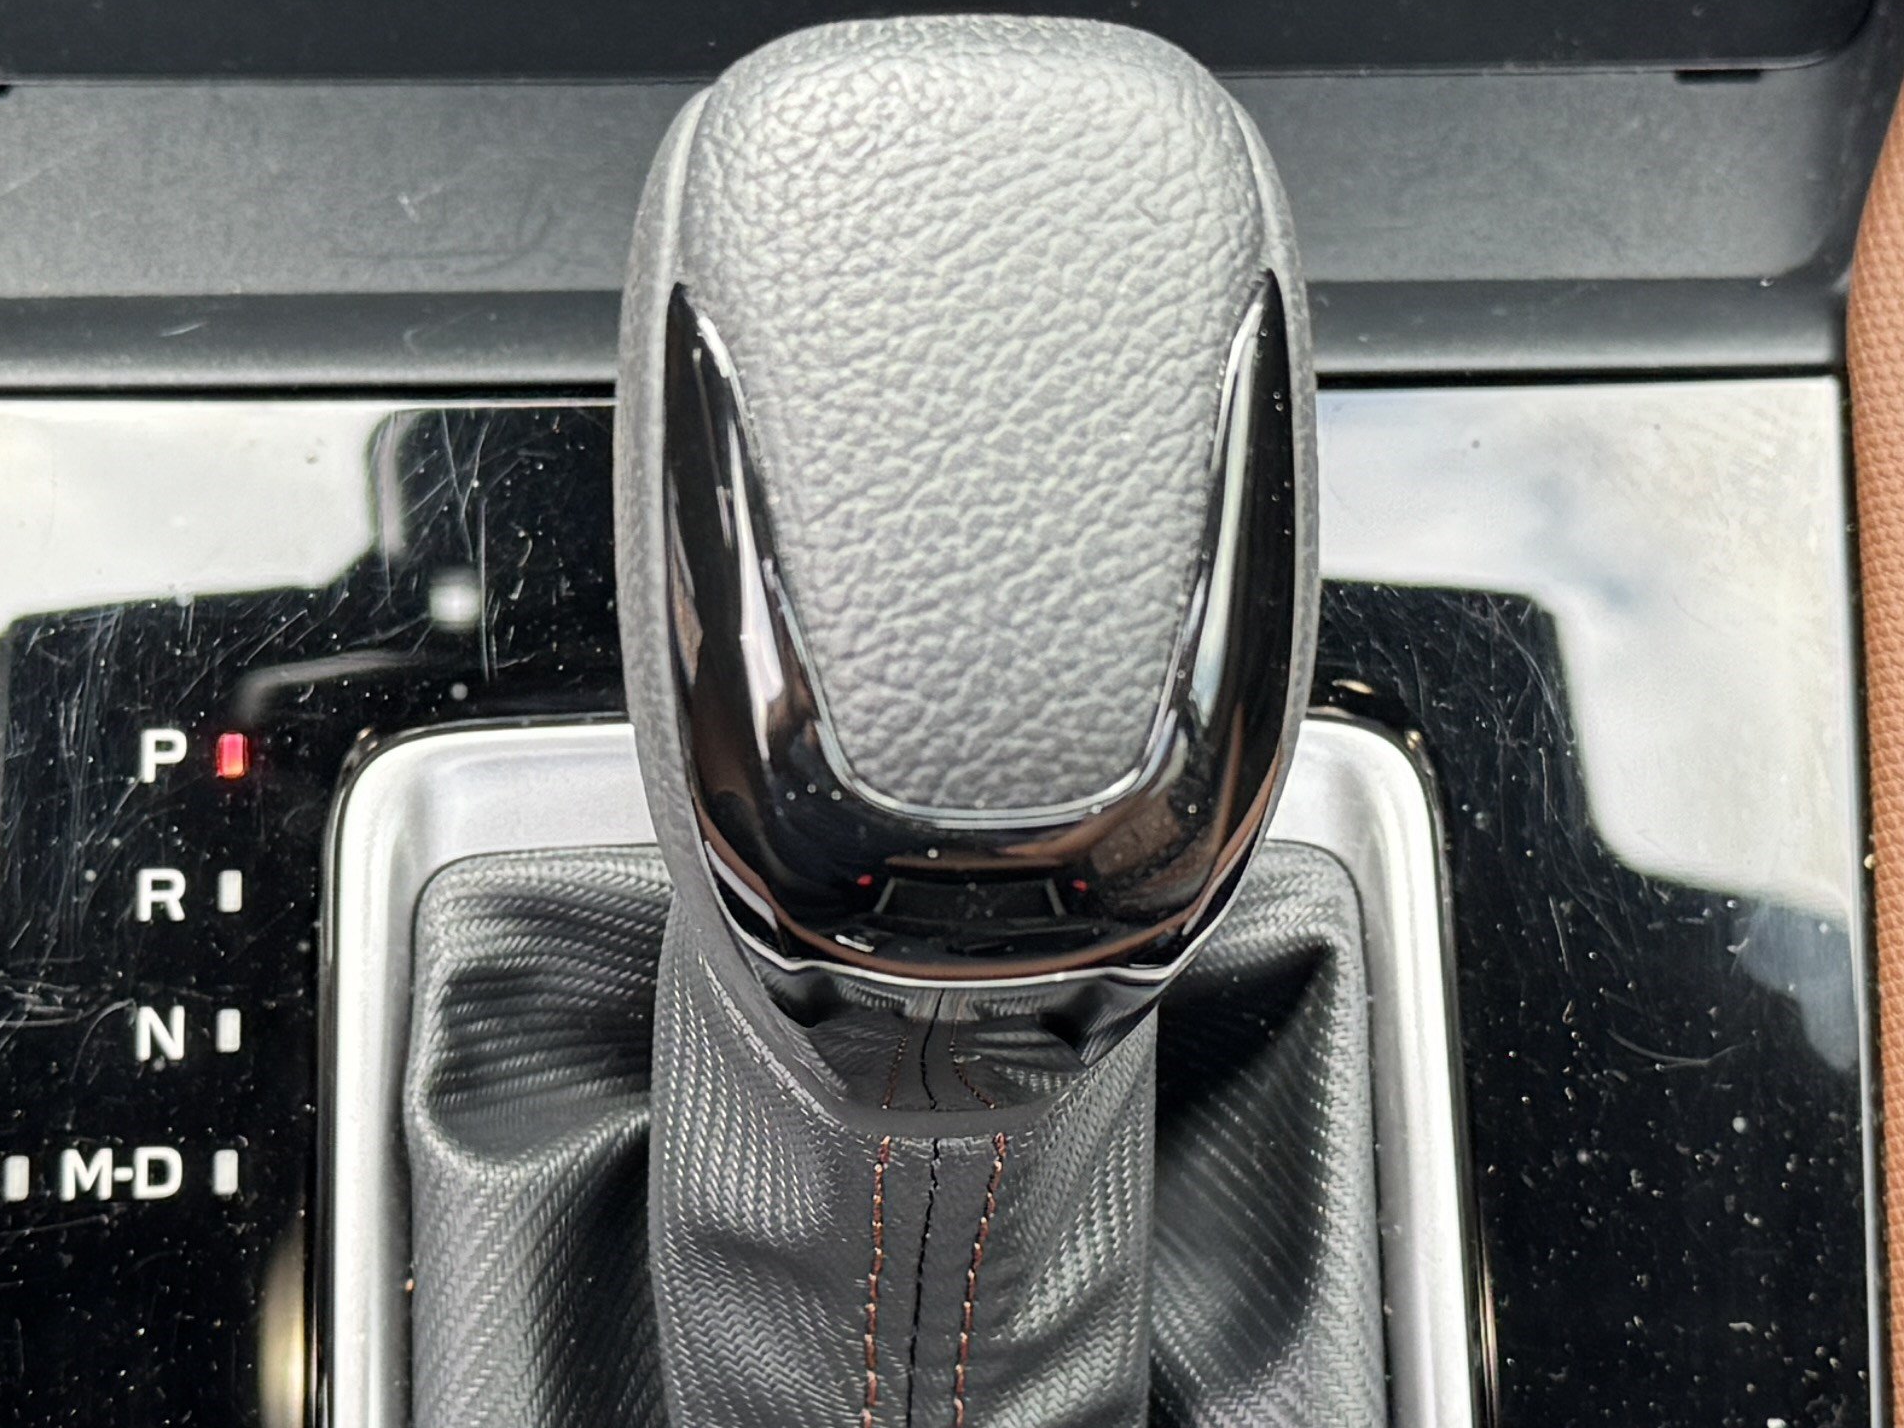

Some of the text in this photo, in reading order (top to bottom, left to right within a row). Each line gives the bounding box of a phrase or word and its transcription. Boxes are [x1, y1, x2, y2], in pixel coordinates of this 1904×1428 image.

[139, 728, 188, 784] P
[136, 868, 186, 922] R
[135, 1005, 185, 1062] N
[60, 1146, 183, 1201] M-D
